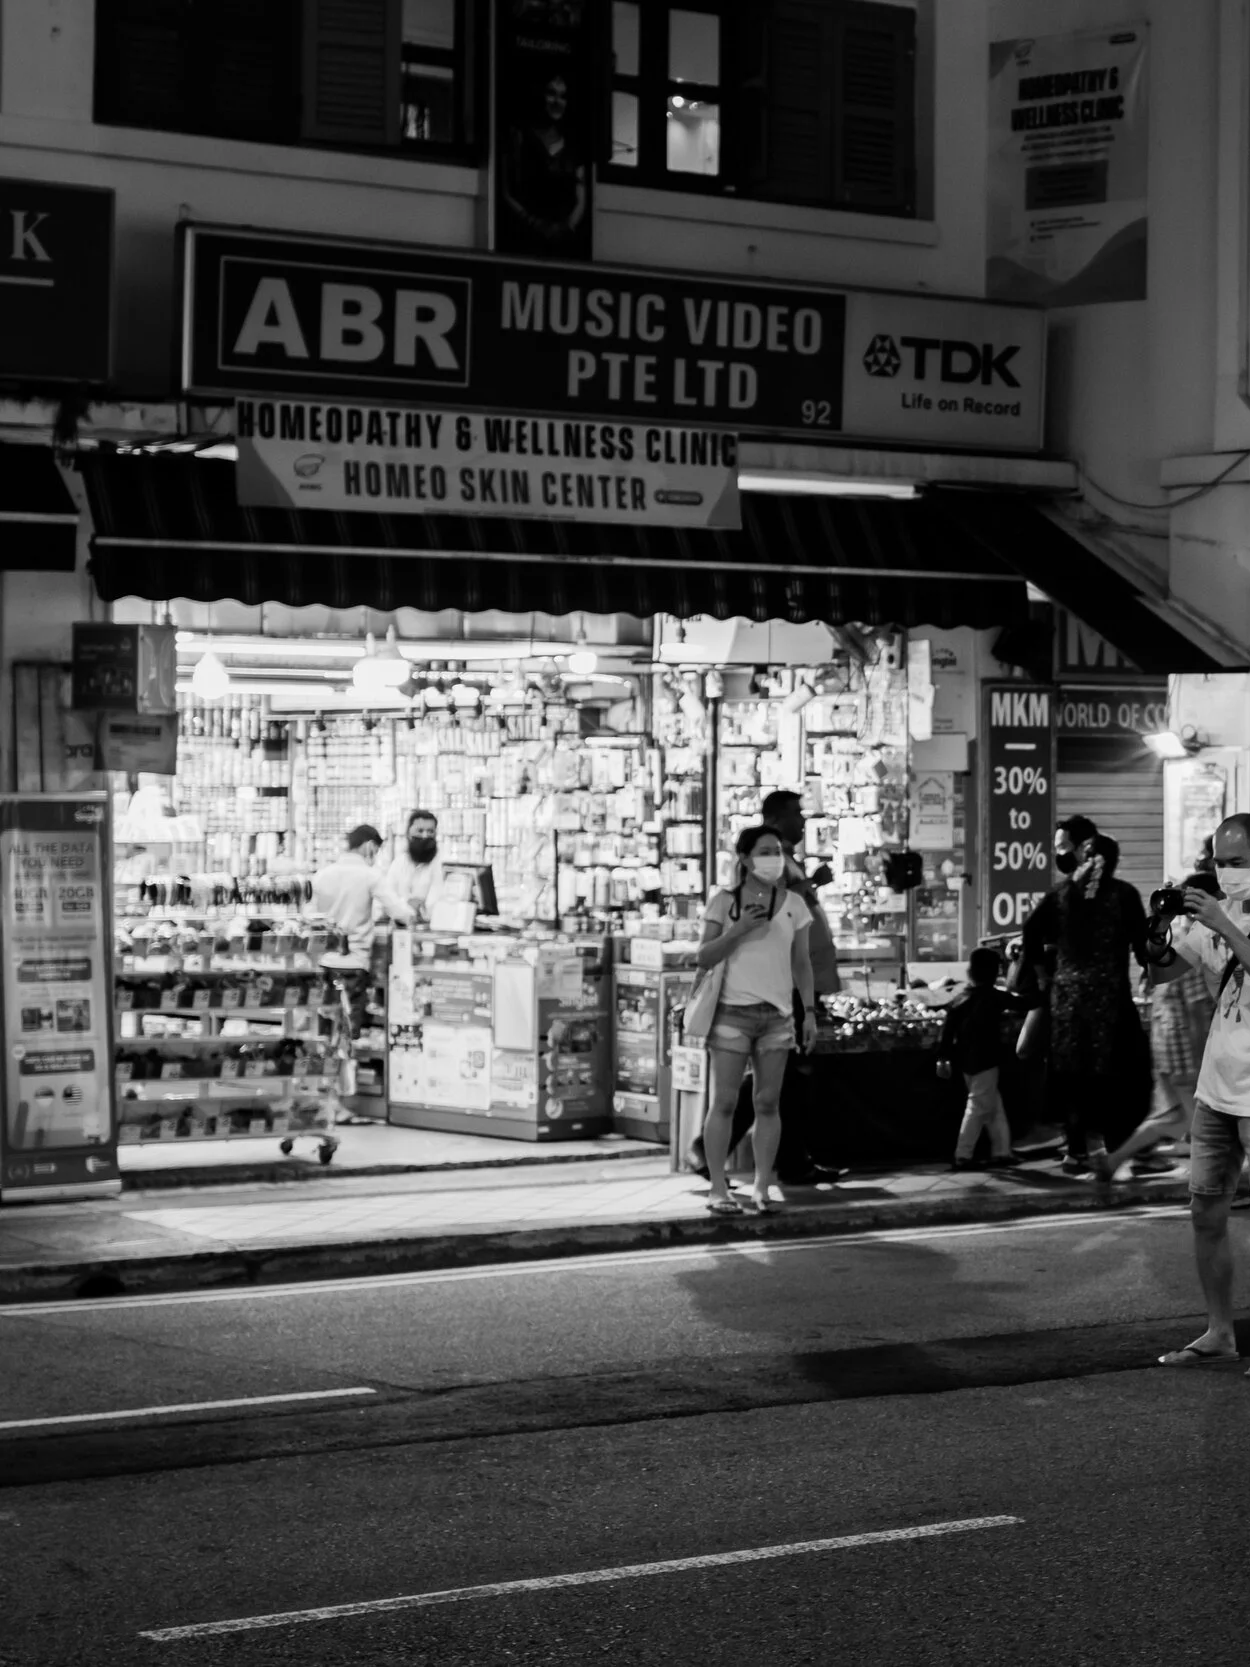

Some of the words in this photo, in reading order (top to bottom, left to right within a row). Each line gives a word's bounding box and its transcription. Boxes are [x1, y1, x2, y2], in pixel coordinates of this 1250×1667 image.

[9, 209, 52, 262] K
[233, 276, 460, 370] ABR
[501, 280, 666, 344] MUSIC
[684, 297, 823, 355] VIDEO
[568, 349, 658, 403] PTE
[673, 358, 759, 410] LTD
[901, 337, 1022, 388] TDK
[801, 400, 832, 426] 92
[902, 392, 933, 412] Life
[938, 399, 960, 413] on
[963, 397, 1022, 417] Record
[238, 401, 443, 450] HOMEOPATHY
[456, 416, 472, 452] &
[484, 417, 636, 461] WELLNESS
[646, 428, 738, 469] CLINIC
[344, 461, 447, 502] HOMEO
[460, 468, 530, 507] SKIN
[541, 473, 648, 511] CENTER
[992, 692, 1050, 727] MKM
[1118, 703, 1140, 728] OF
[993, 766, 1047, 795] 30%
[1009, 807, 1031, 830] to
[35, 843, 57, 855] THE
[61, 842, 95, 854] DATA
[993, 841, 1047, 870] 50%
